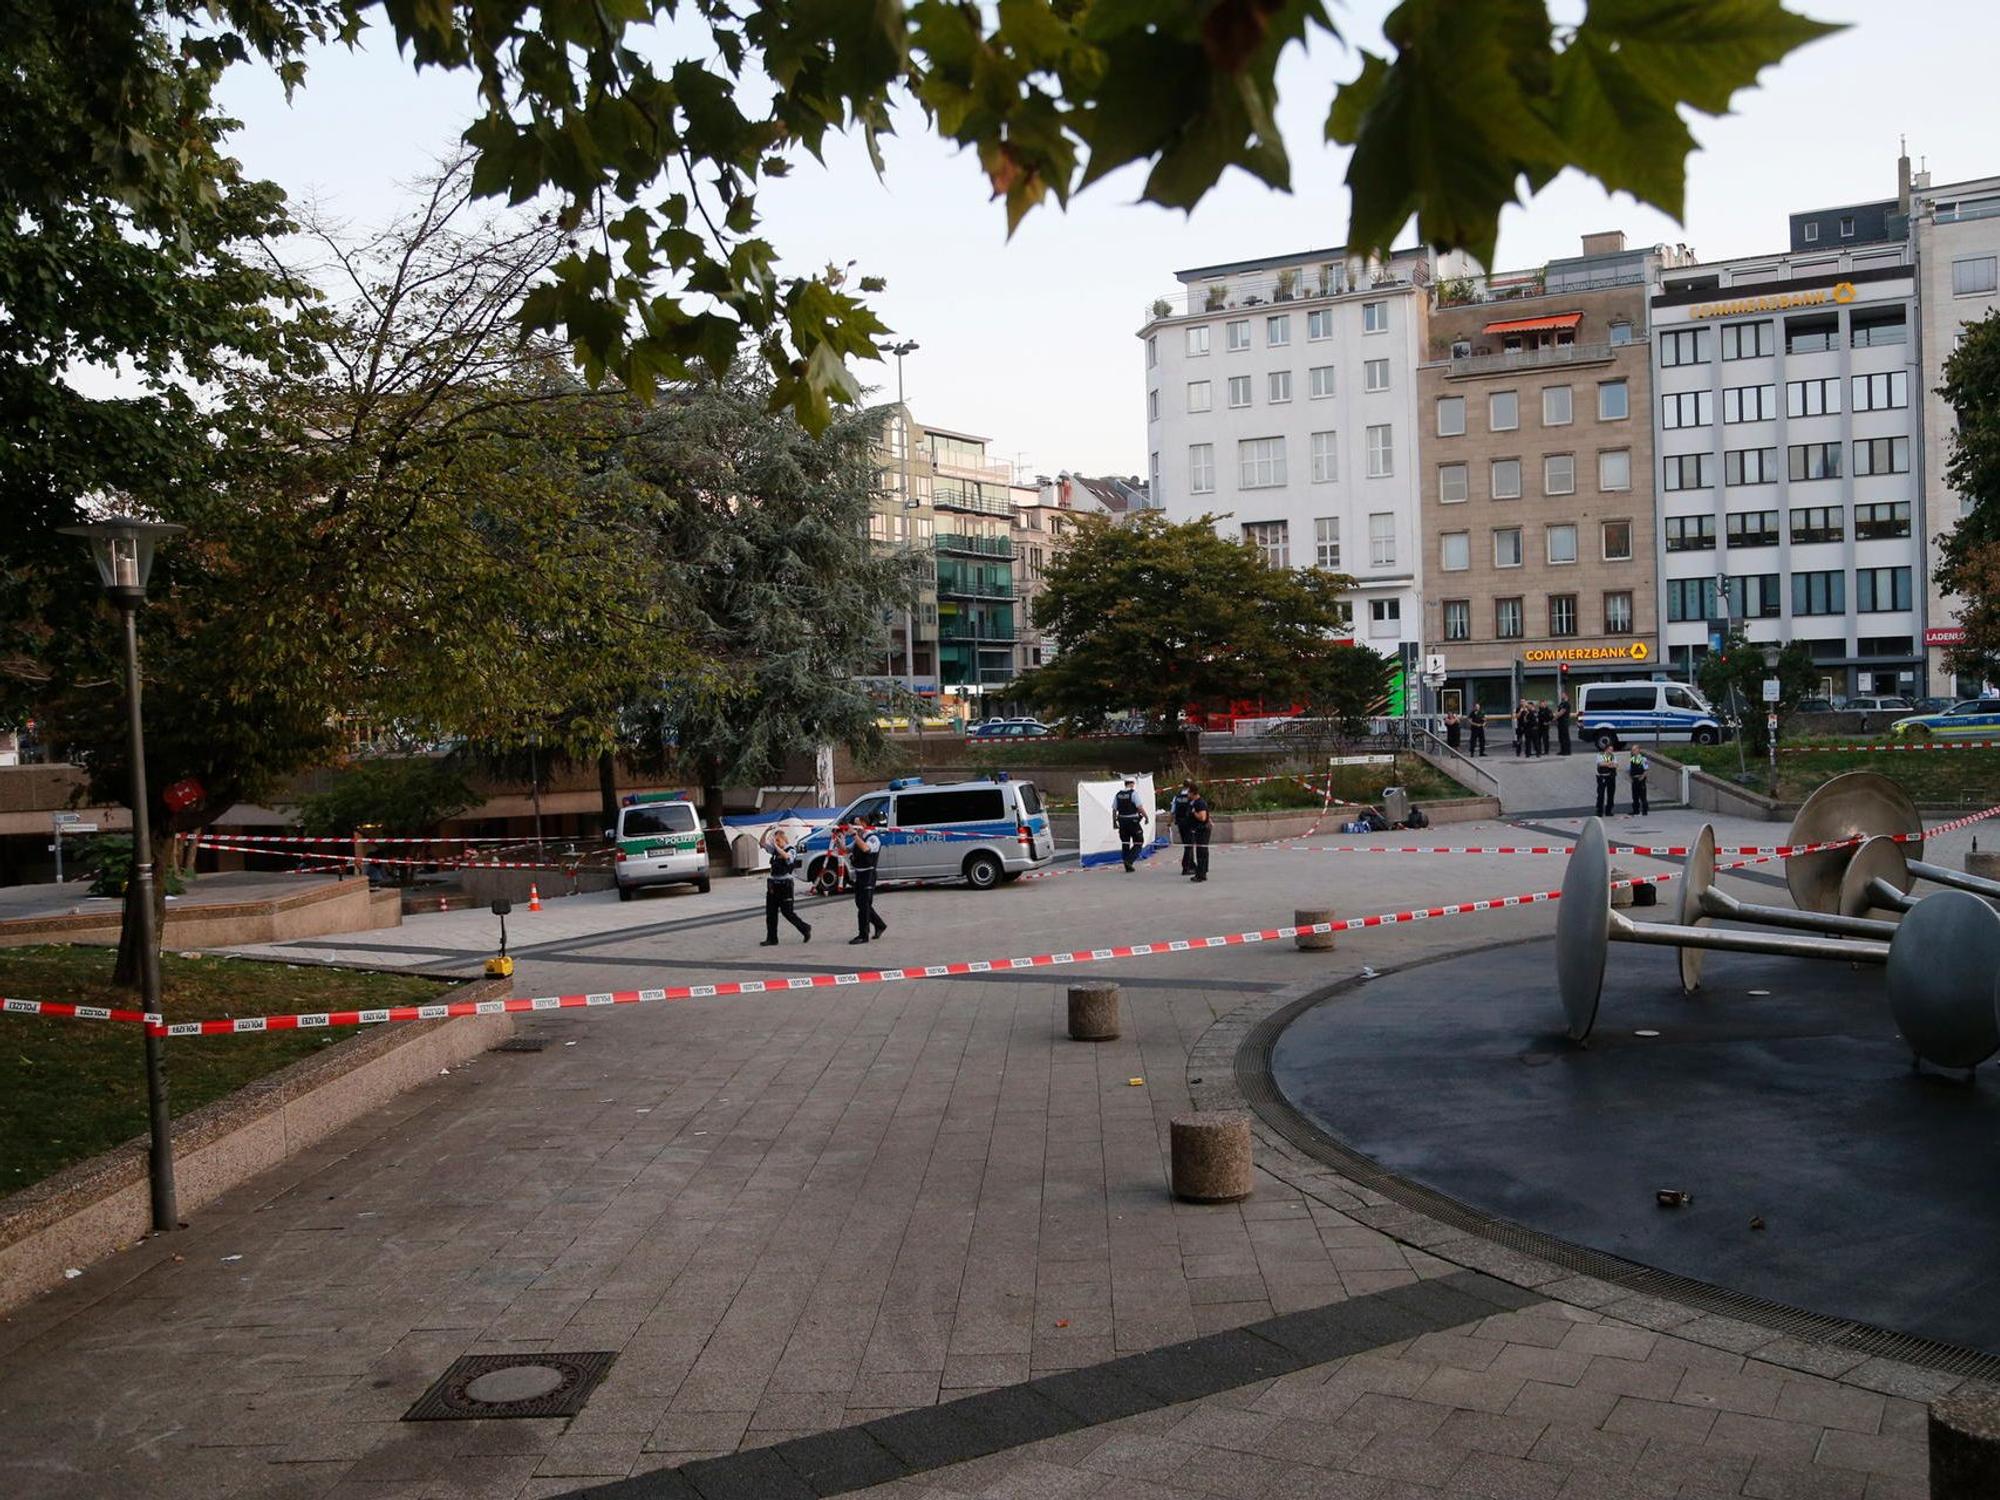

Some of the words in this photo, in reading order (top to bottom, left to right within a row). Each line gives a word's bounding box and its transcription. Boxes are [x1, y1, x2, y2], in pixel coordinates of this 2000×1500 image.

[1526, 647, 1626, 660] COMMERZBANK
[664, 834, 698, 845] POLIZEI
[906, 833, 946, 844] POLIZEI
[642, 991, 664, 1000] POLIZEI
[692, 987, 714, 996] POLIZEI
[535, 999, 558, 1008] POLIZEI
[589, 995, 611, 1005] POLIZEI
[8, 1000, 37, 1011] POLIZEI
[479, 1004, 502, 1013] POLIZEI
[79, 1008, 108, 1017] POLIZEI
[362, 1010, 386, 1021] POLIZEI
[422, 1008, 445, 1017] POLIZEI
[301, 1014, 326, 1025] POLIZEI
[172, 1025, 198, 1034] POLIZEI
[238, 1020, 263, 1031] POLIZEI
